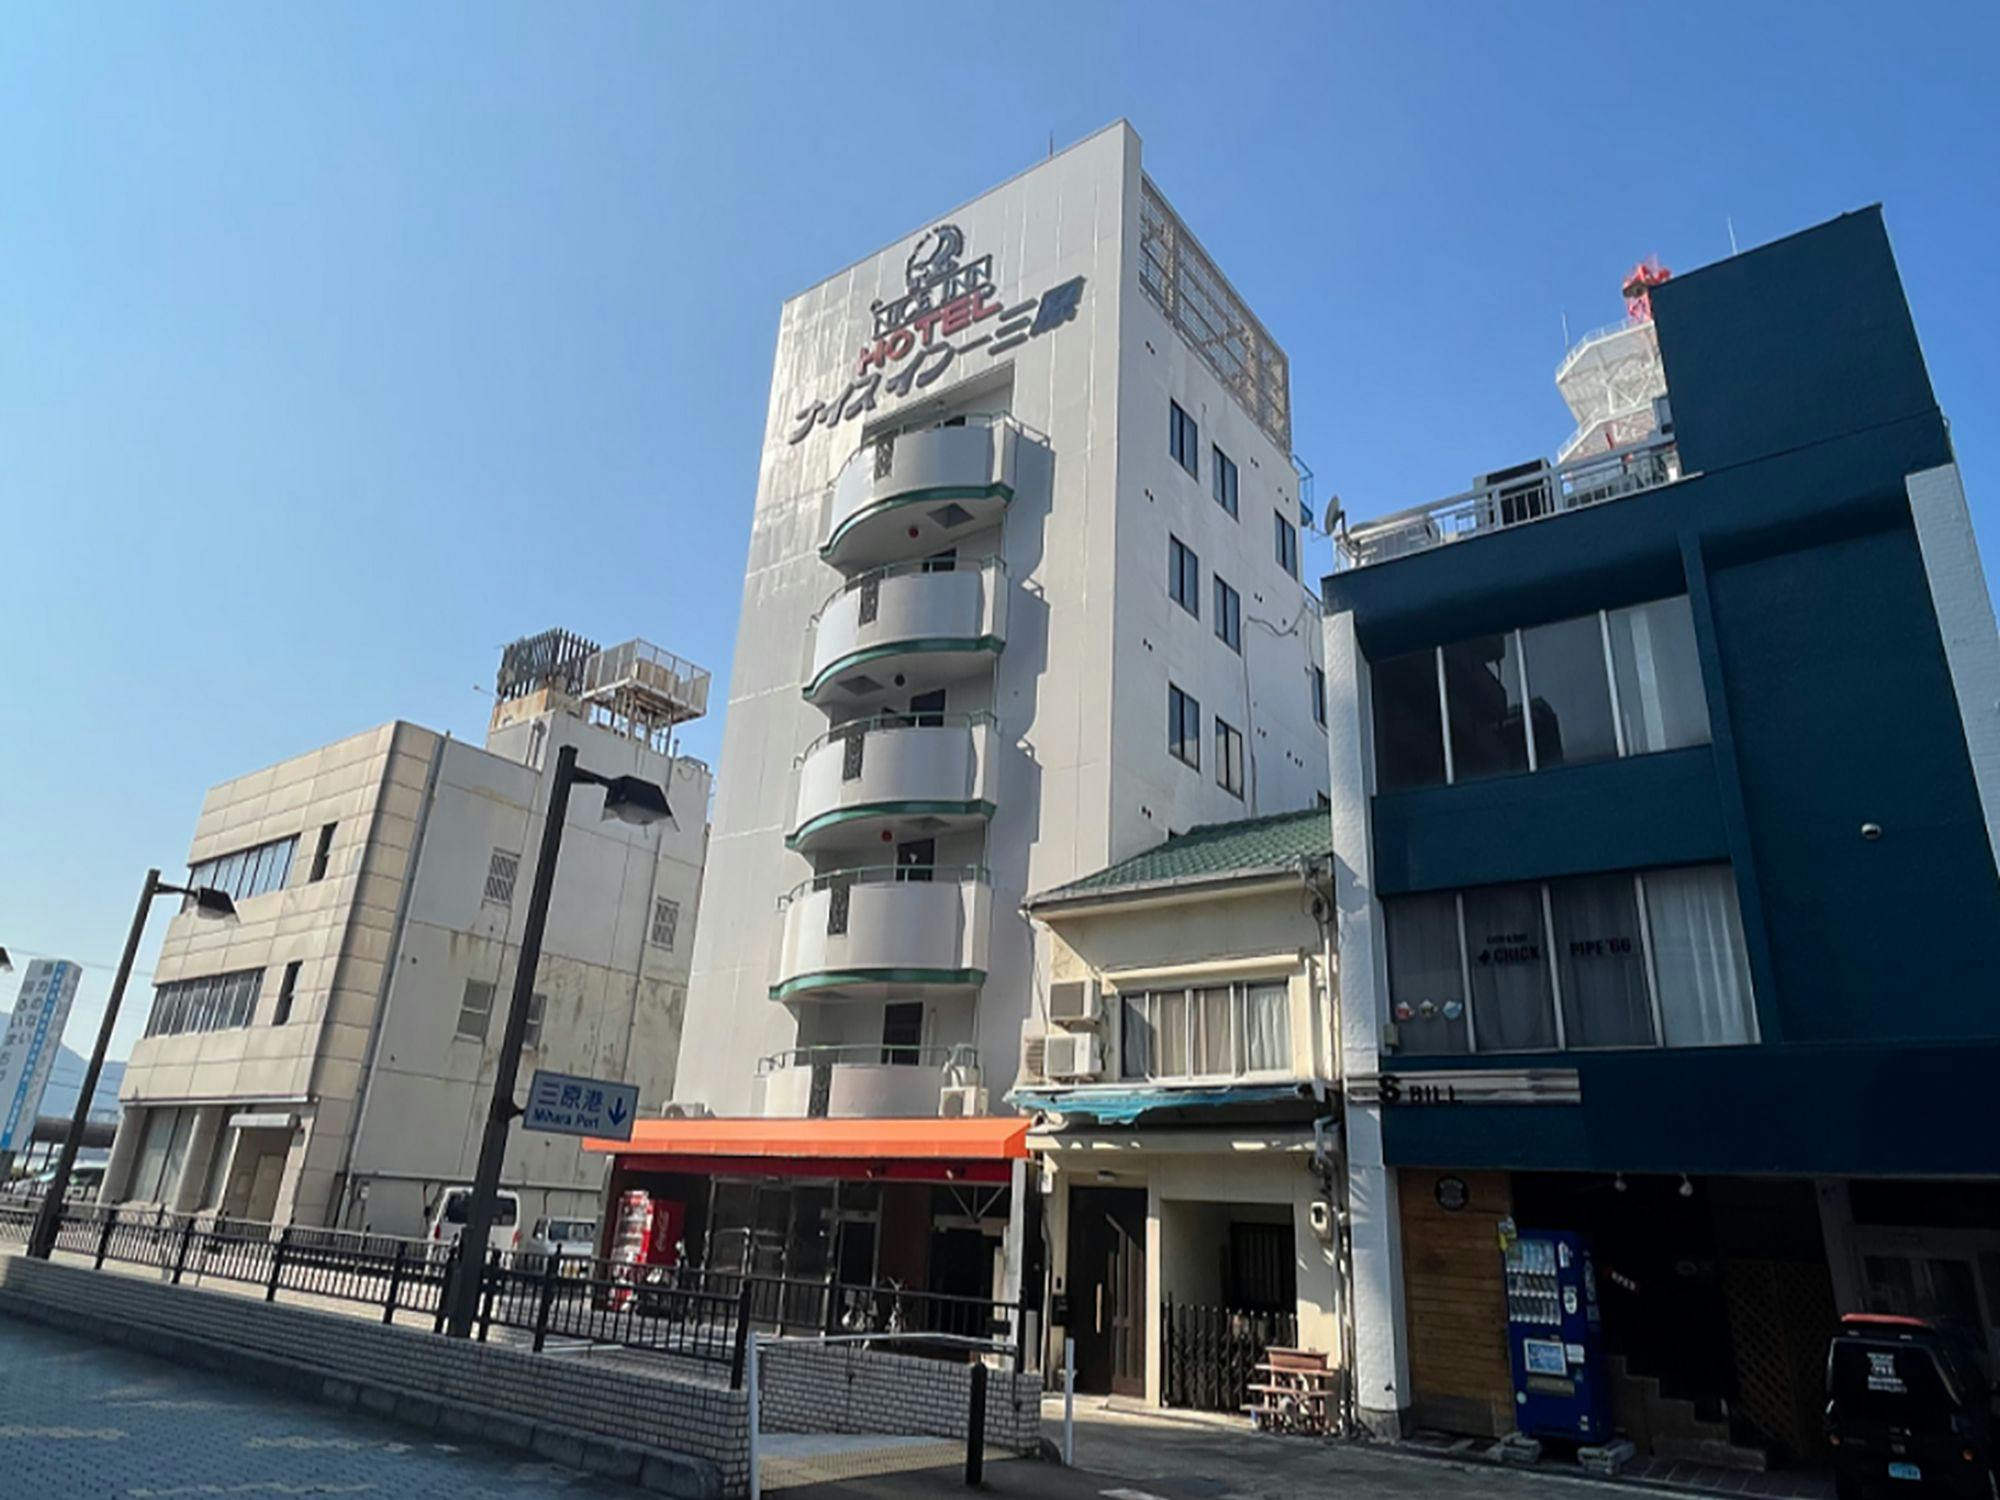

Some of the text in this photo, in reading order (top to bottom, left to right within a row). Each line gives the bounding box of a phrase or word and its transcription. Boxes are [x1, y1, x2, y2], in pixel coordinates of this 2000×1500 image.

[857, 290, 1004, 377] HOTEL
[537, 1081, 604, 1113] 三原港
[1408, 1084, 1463, 1104] BILL
[576, 1113, 600, 1129] Port
